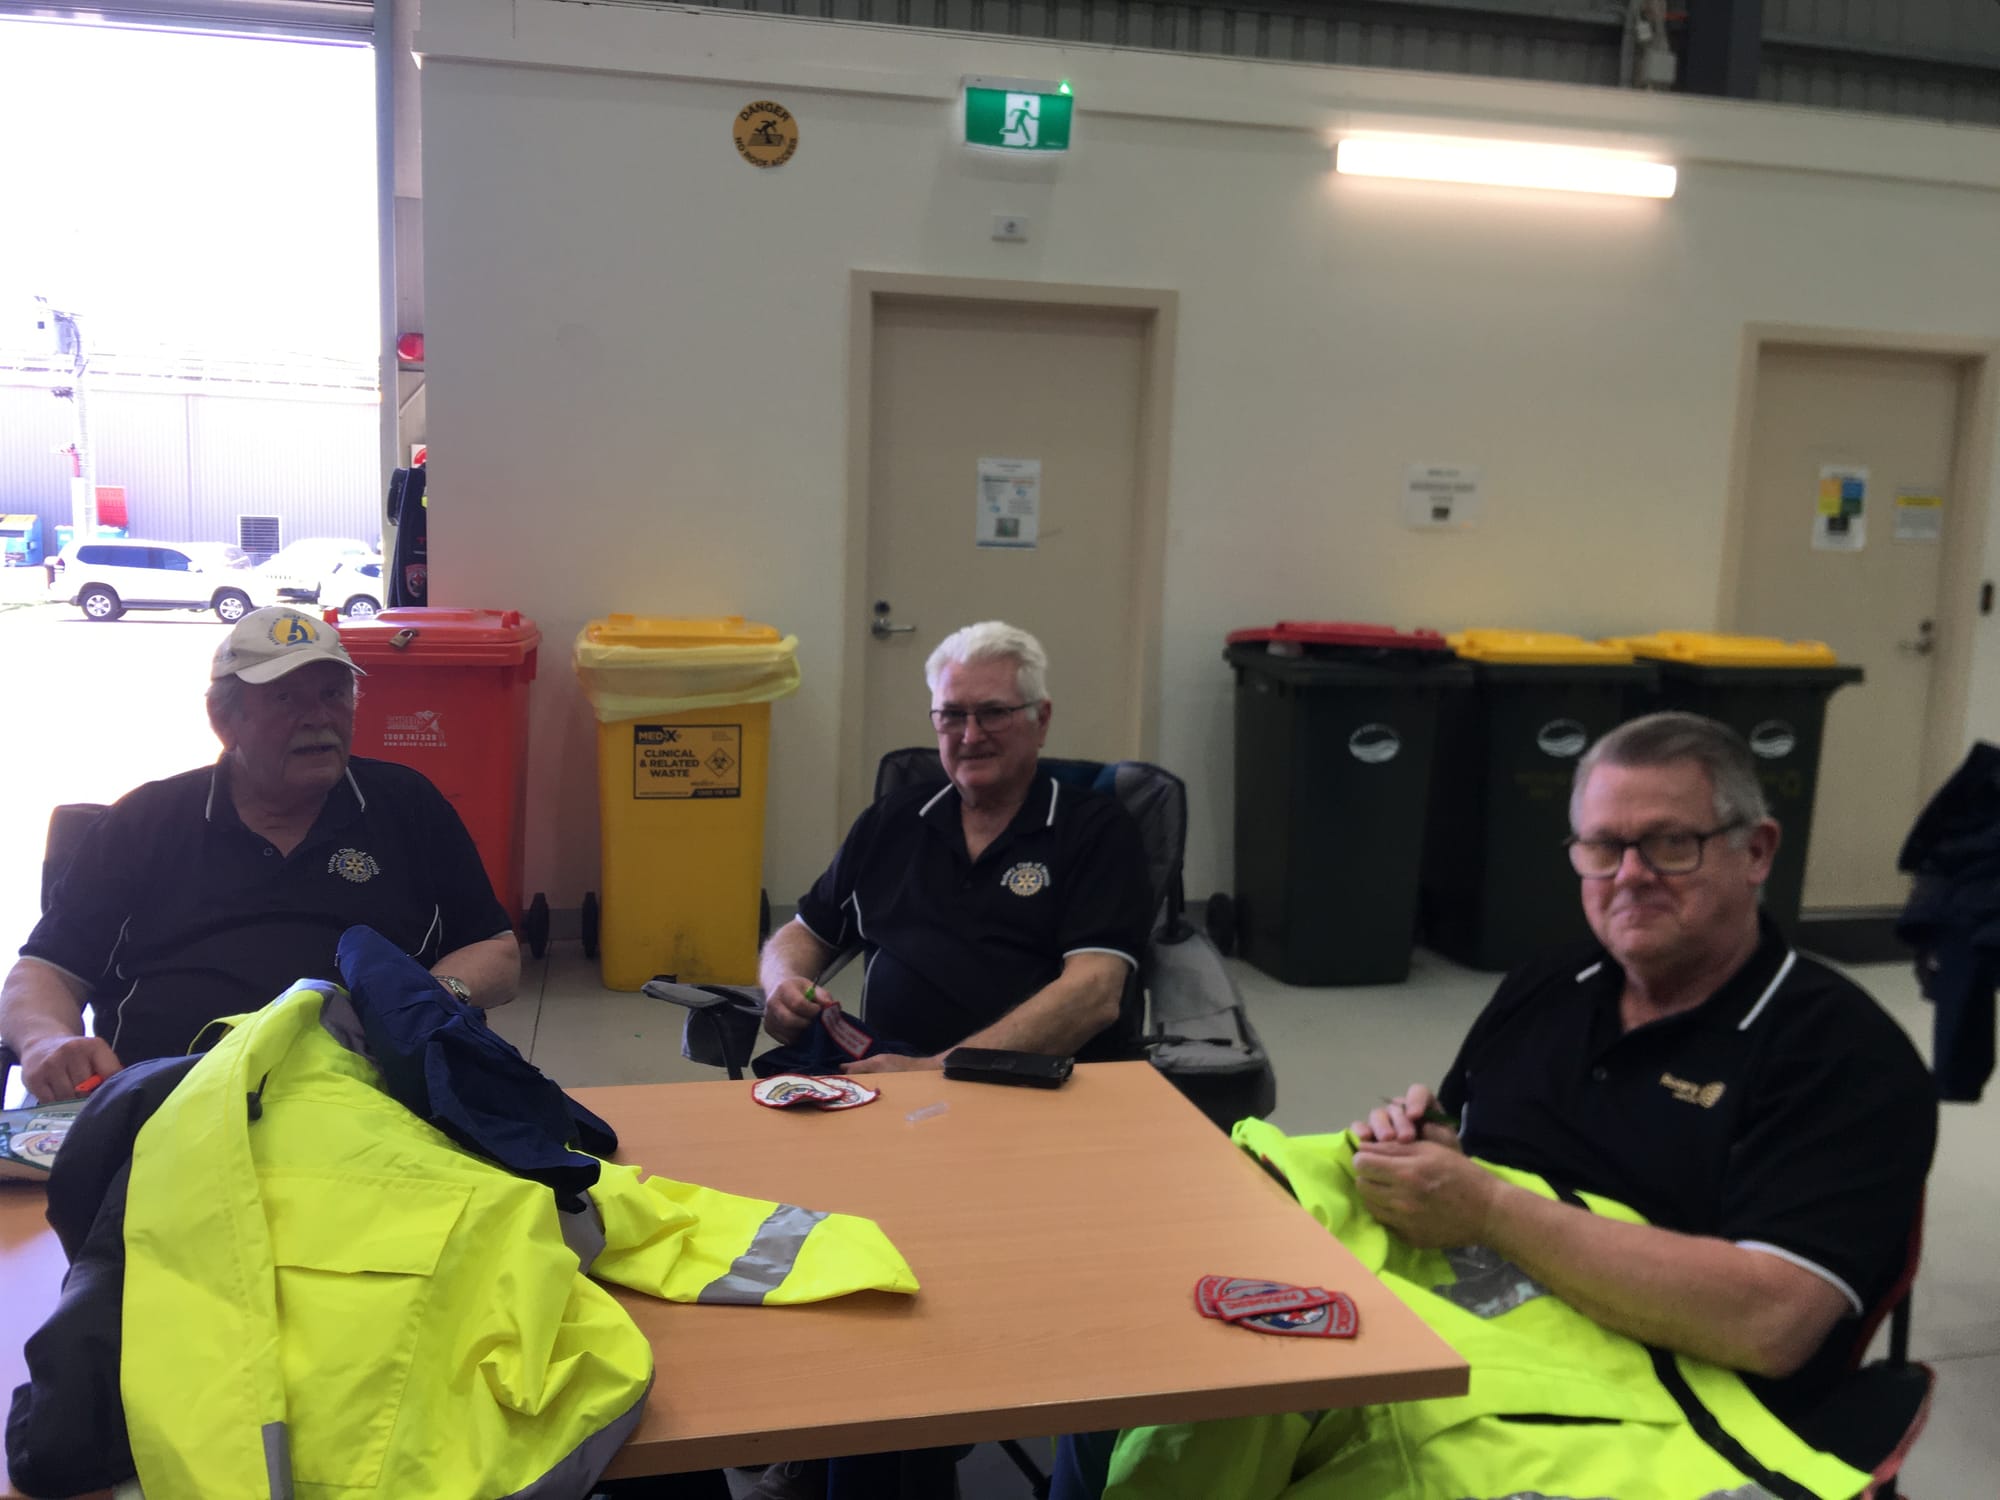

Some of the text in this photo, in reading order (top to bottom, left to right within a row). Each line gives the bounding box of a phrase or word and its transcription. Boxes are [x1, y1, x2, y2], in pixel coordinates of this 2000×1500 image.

[740, 102, 791, 121] DANGER
[735, 136, 746, 151] NO
[644, 749, 696, 758] CLINICAL
[639, 760, 700, 768] & RELATED
[650, 769, 690, 778] WASTE
